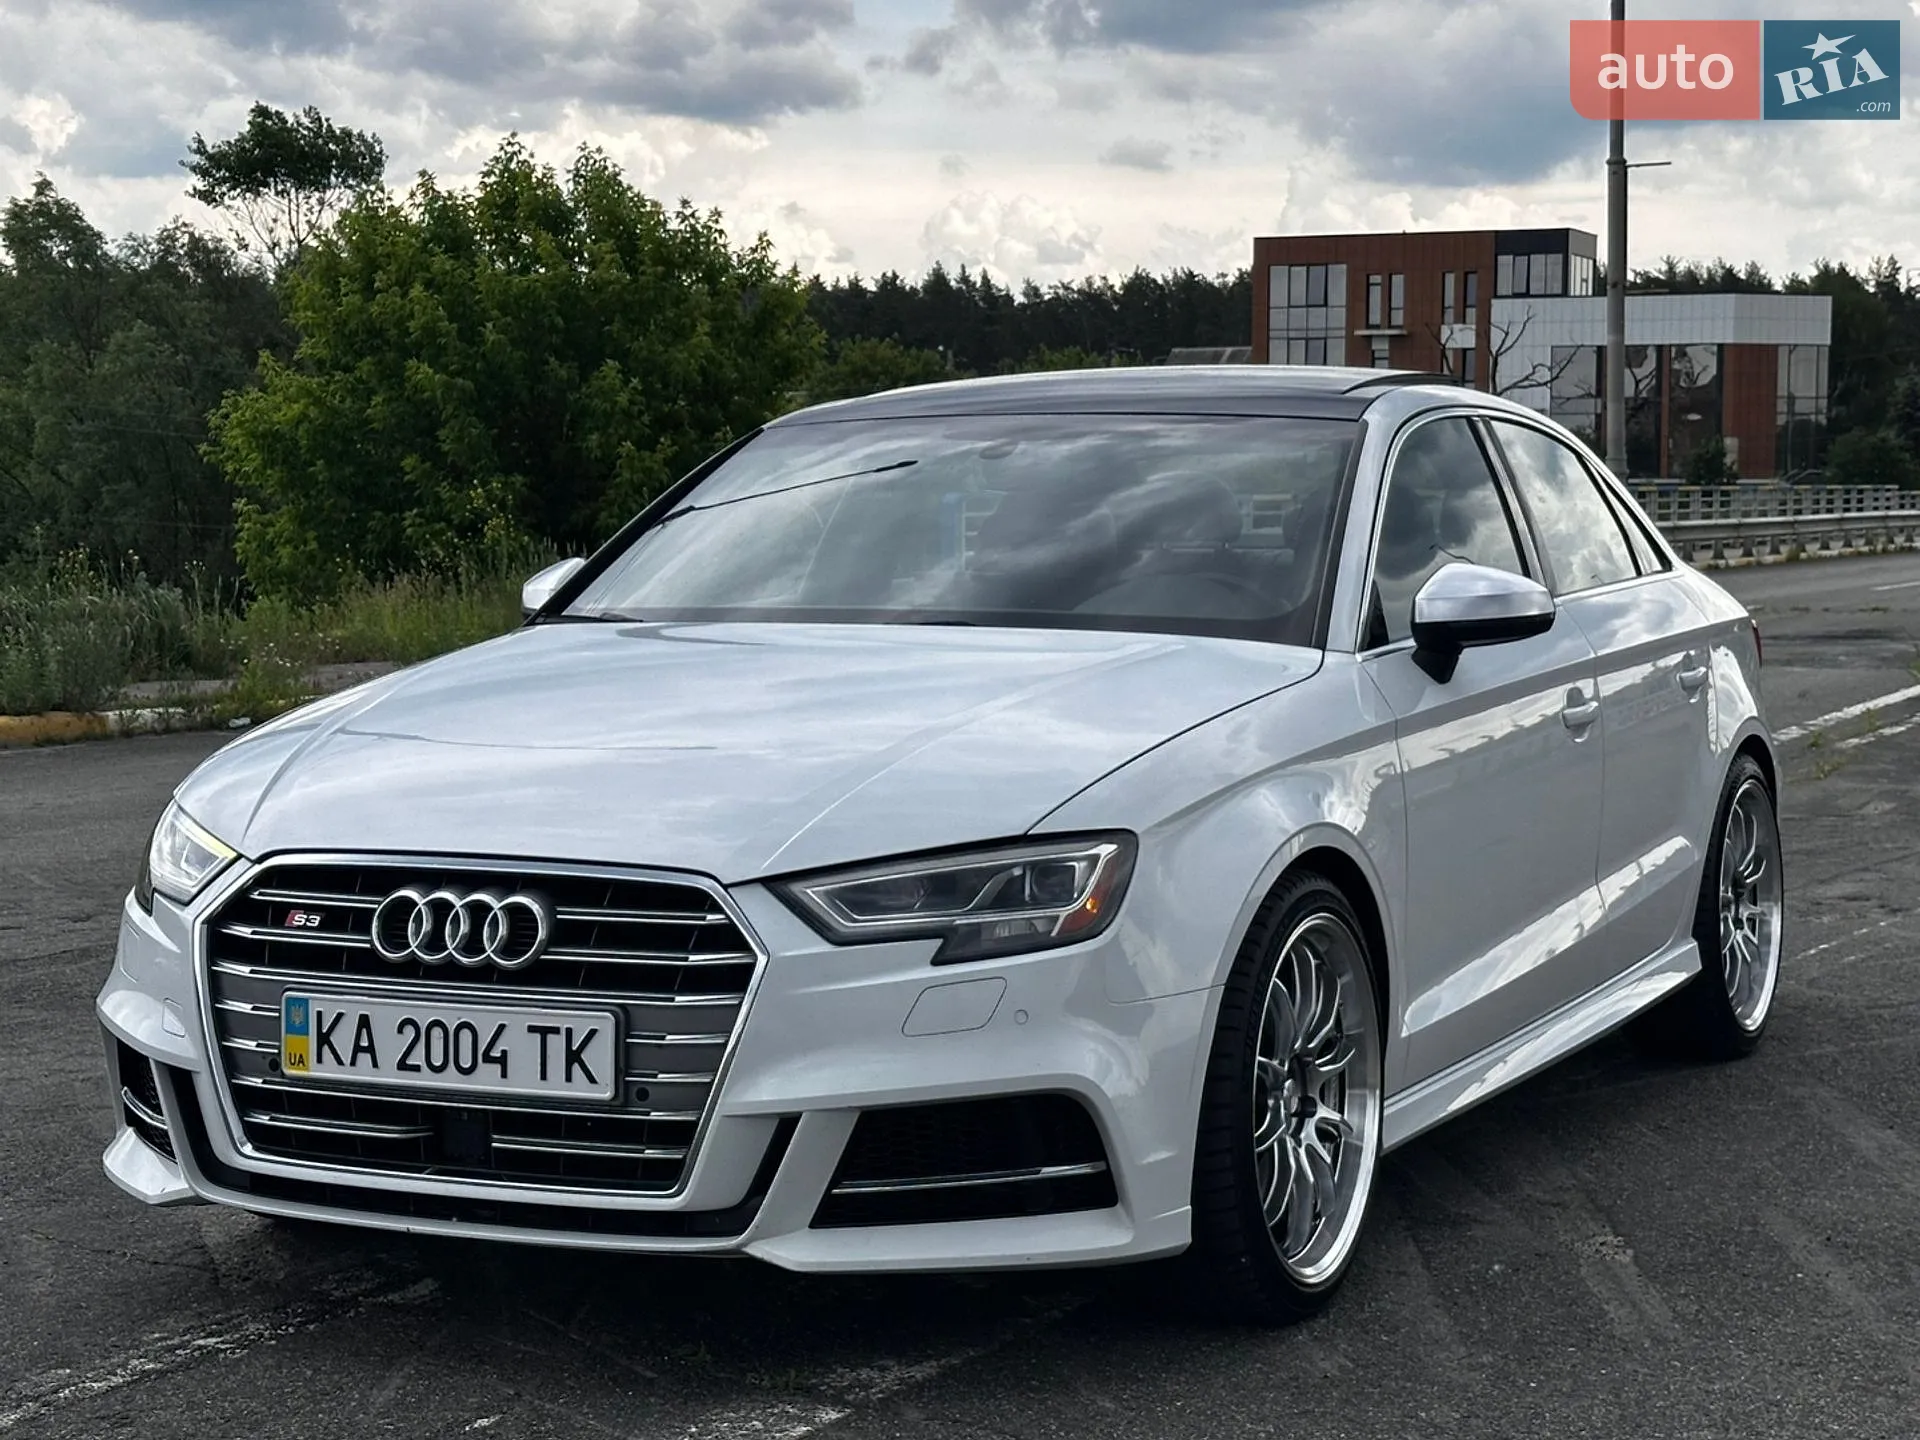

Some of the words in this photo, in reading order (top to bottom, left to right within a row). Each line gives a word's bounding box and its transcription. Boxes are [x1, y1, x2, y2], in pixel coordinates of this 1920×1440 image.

[292, 913, 321, 927] S3
[315, 1009, 379, 1070] KA
[396, 1017, 508, 1079] 2004
[527, 1024, 599, 1084] TK
[288, 1052, 305, 1067] UA
